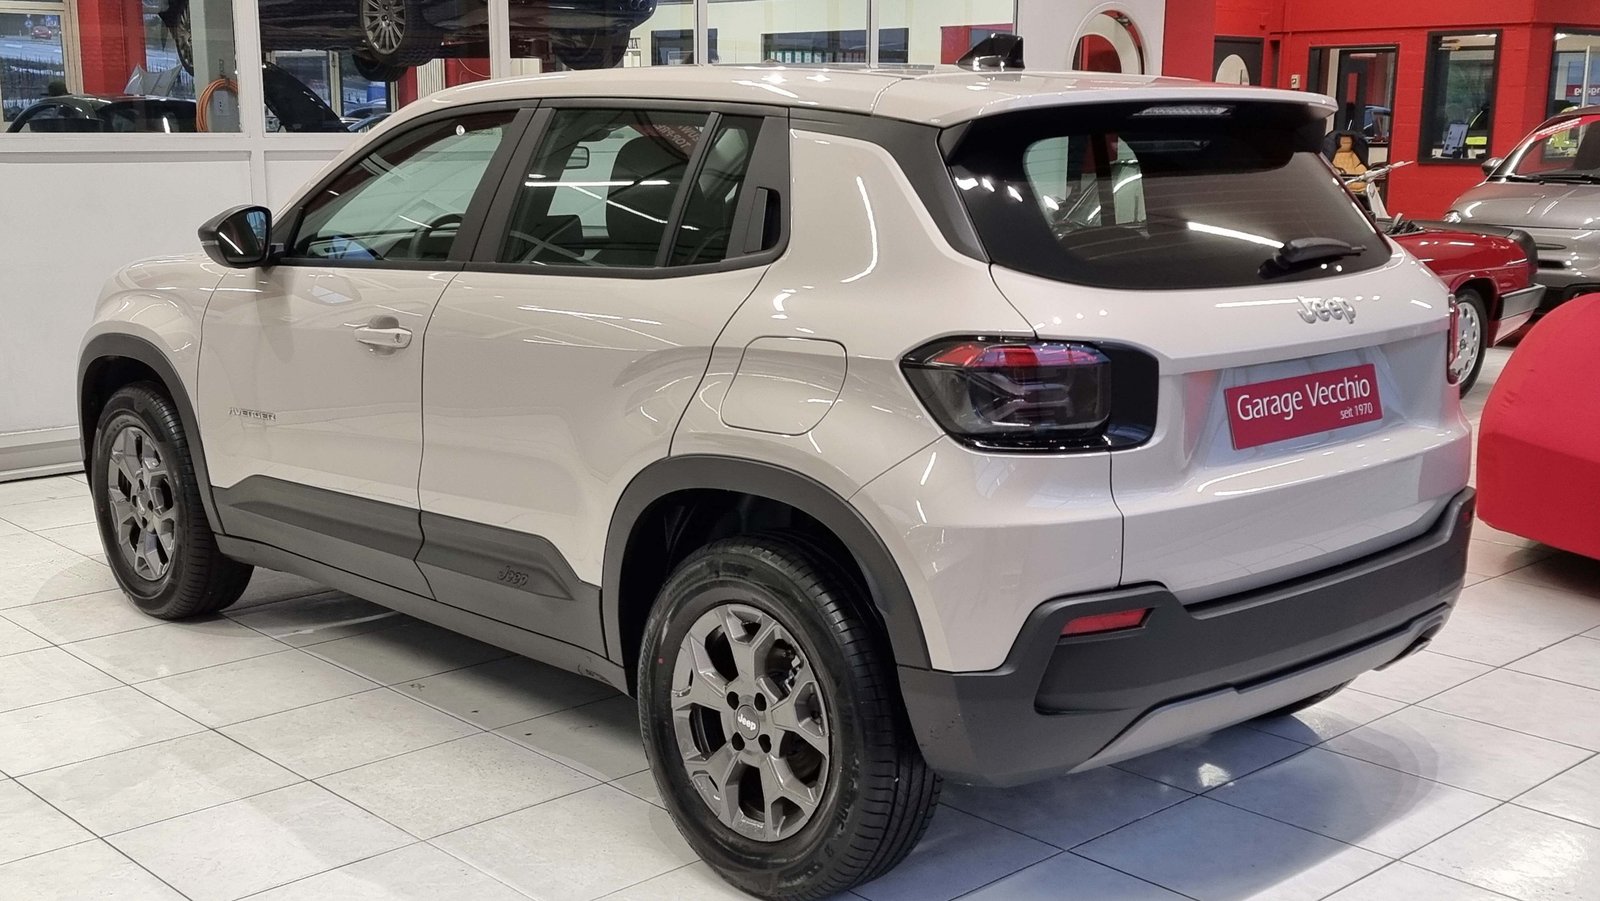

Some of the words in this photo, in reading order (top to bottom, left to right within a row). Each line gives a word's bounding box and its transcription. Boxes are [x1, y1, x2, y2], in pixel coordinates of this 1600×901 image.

[1297, 296, 1356, 324] Jeep
[1237, 391, 1304, 420] Garage
[1305, 374, 1371, 407] Vecchio
[228, 407, 277, 421] AVENGER
[1339, 407, 1354, 420] seit
[1355, 402, 1374, 417] 1970
[497, 565, 529, 586] Jeep
[737, 713, 757, 731] Jeep
